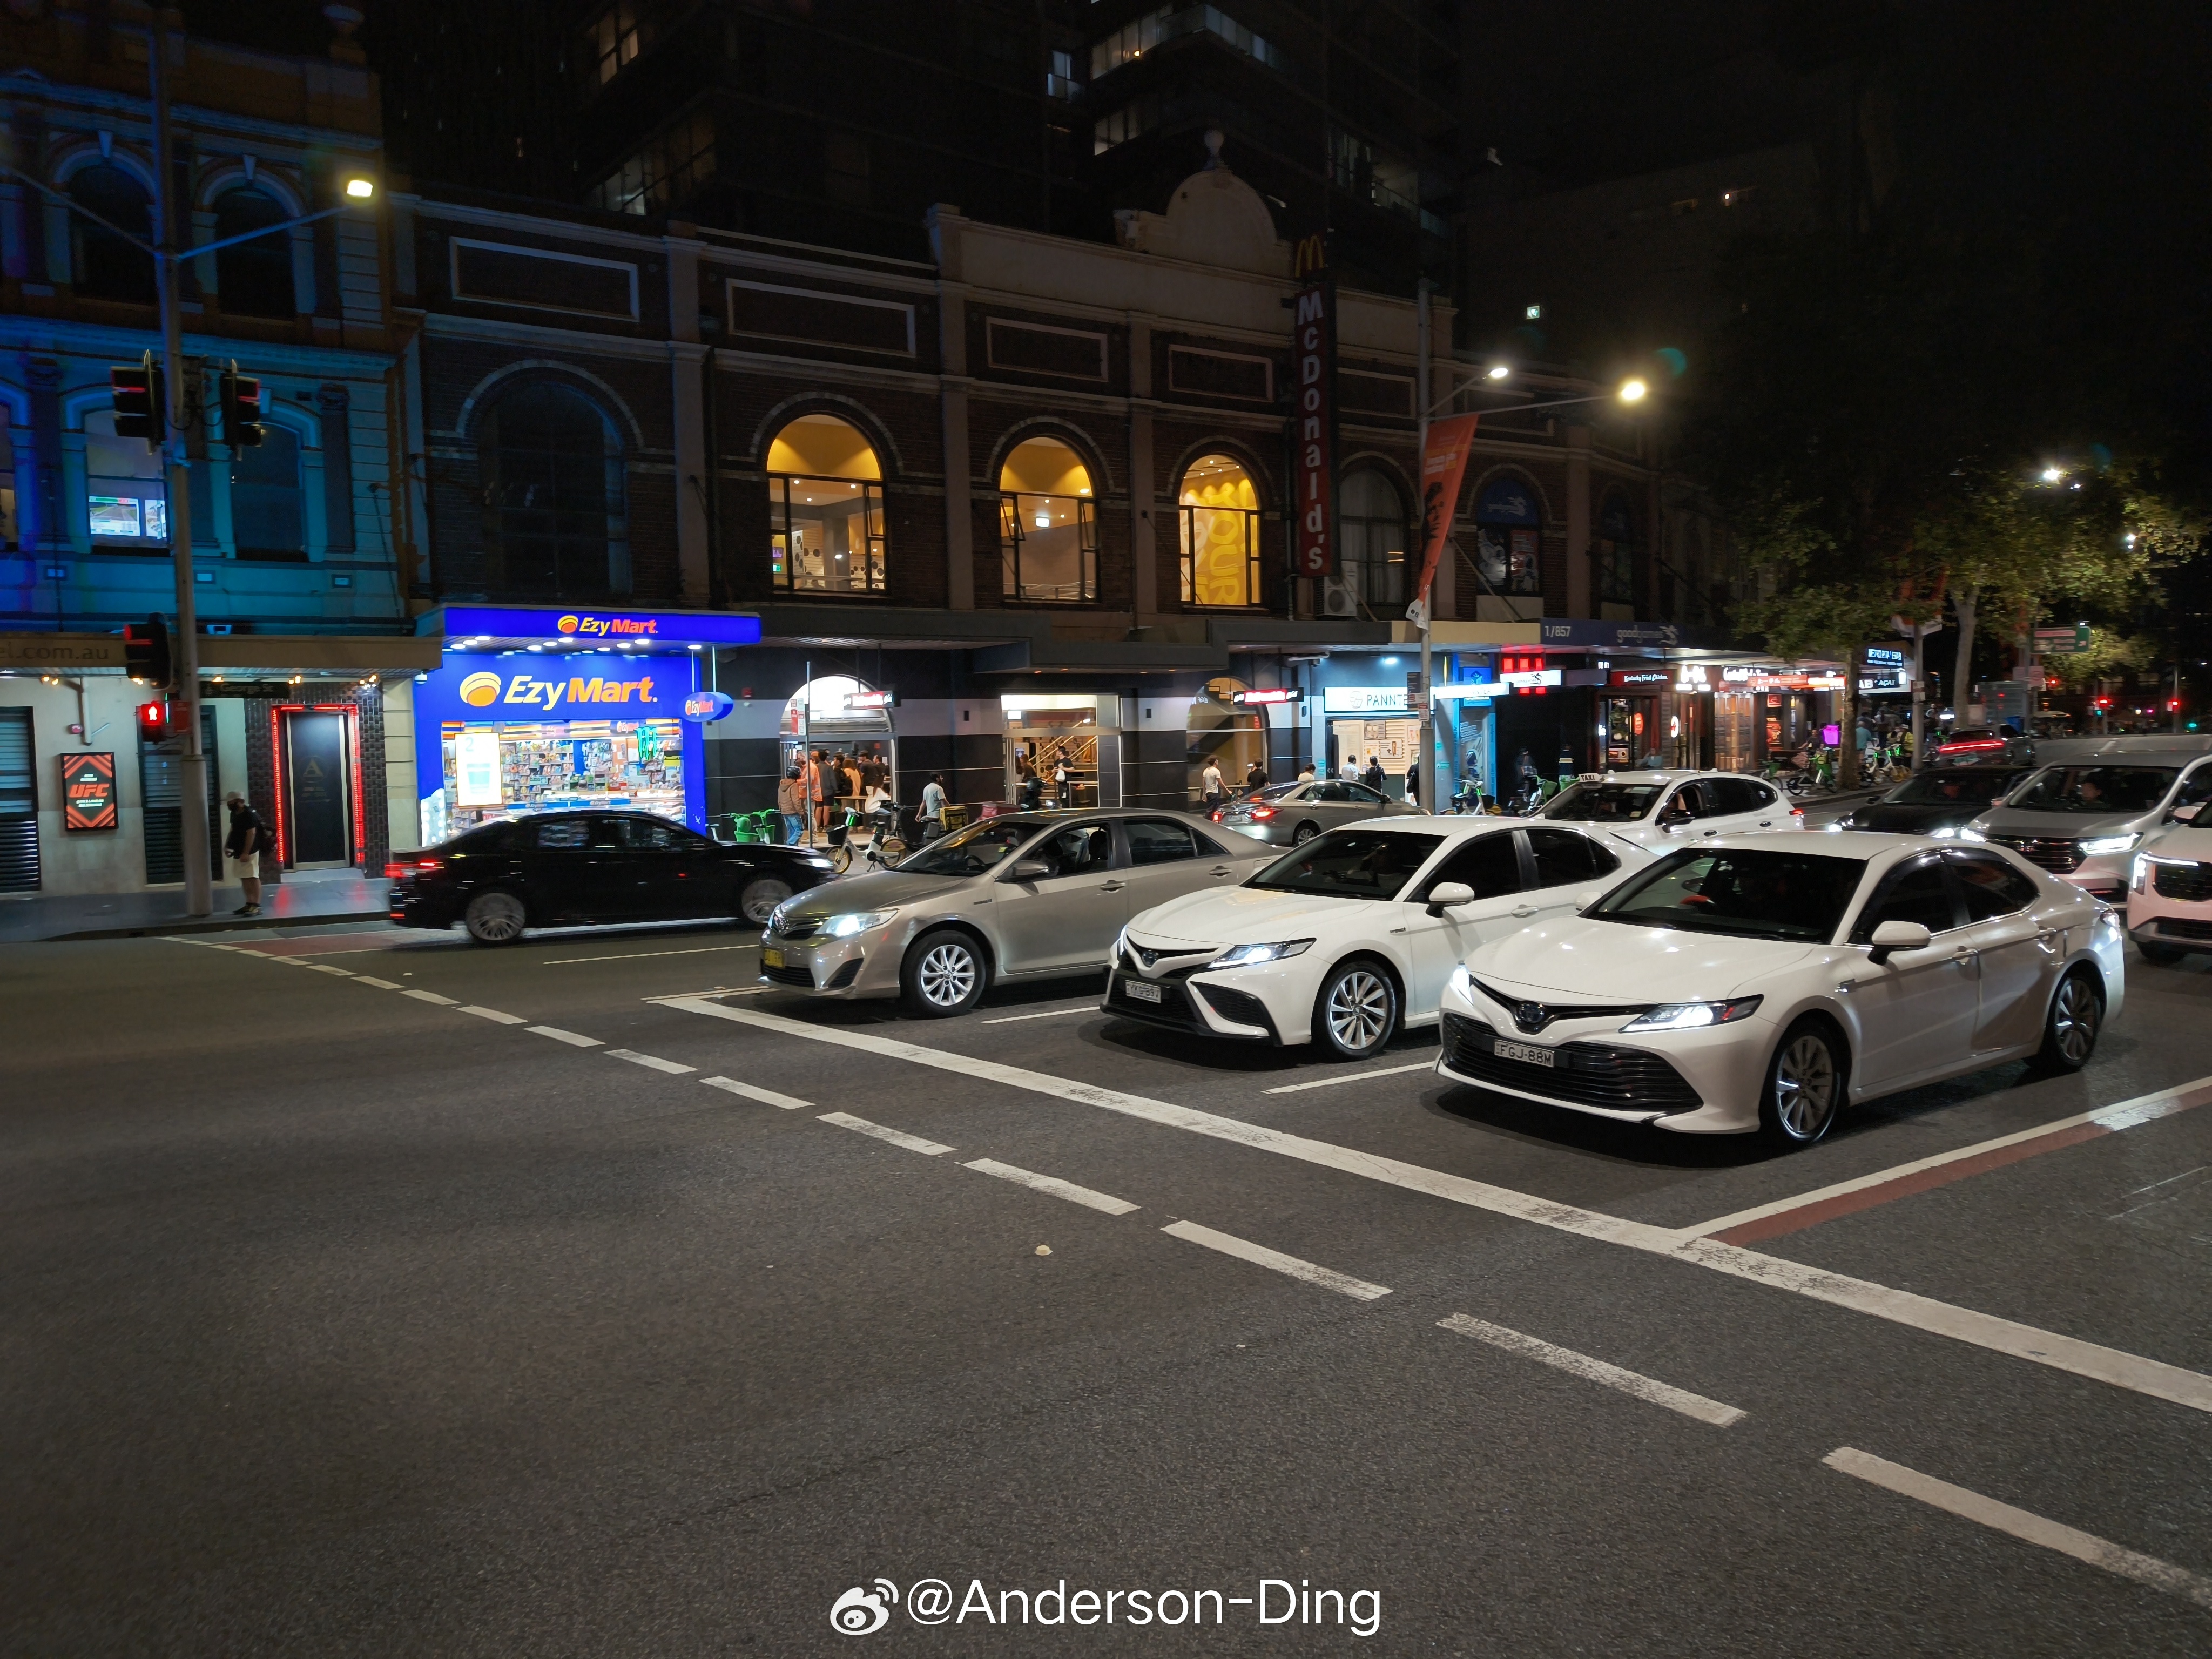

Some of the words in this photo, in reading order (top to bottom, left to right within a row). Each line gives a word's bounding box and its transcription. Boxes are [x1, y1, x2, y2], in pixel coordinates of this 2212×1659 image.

[1298, 290, 1325, 570] McDonald's
[1544, 625, 1571, 638] 1/857
[69, 783, 110, 798] UFC
